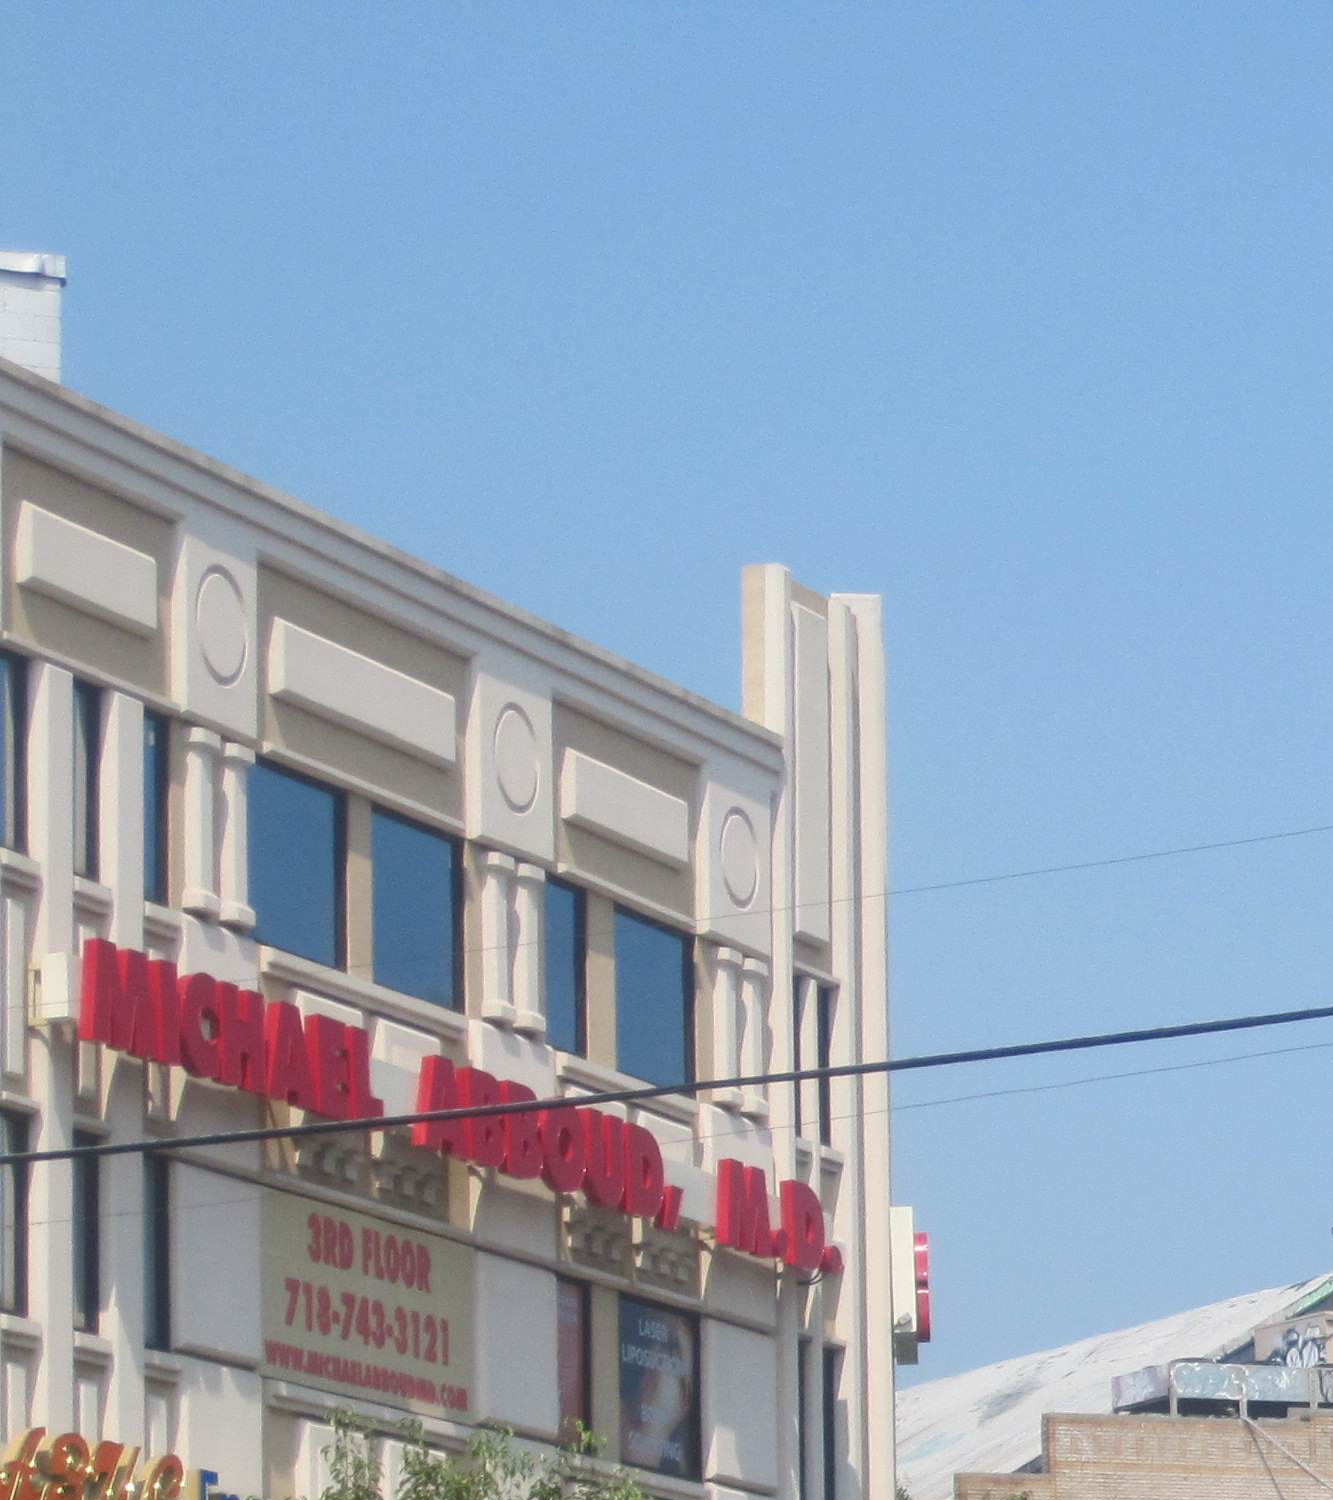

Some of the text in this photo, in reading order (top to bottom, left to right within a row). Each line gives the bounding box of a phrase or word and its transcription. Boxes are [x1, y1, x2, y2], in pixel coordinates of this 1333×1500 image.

[78, 938, 843, 1275] MICHAEL ABBOUD, M.D.
[307, 1213, 432, 1294] 3RD FLOOR
[284, 1276, 450, 1367] 718-743-3121
[637, 1317, 669, 1343] LASER
